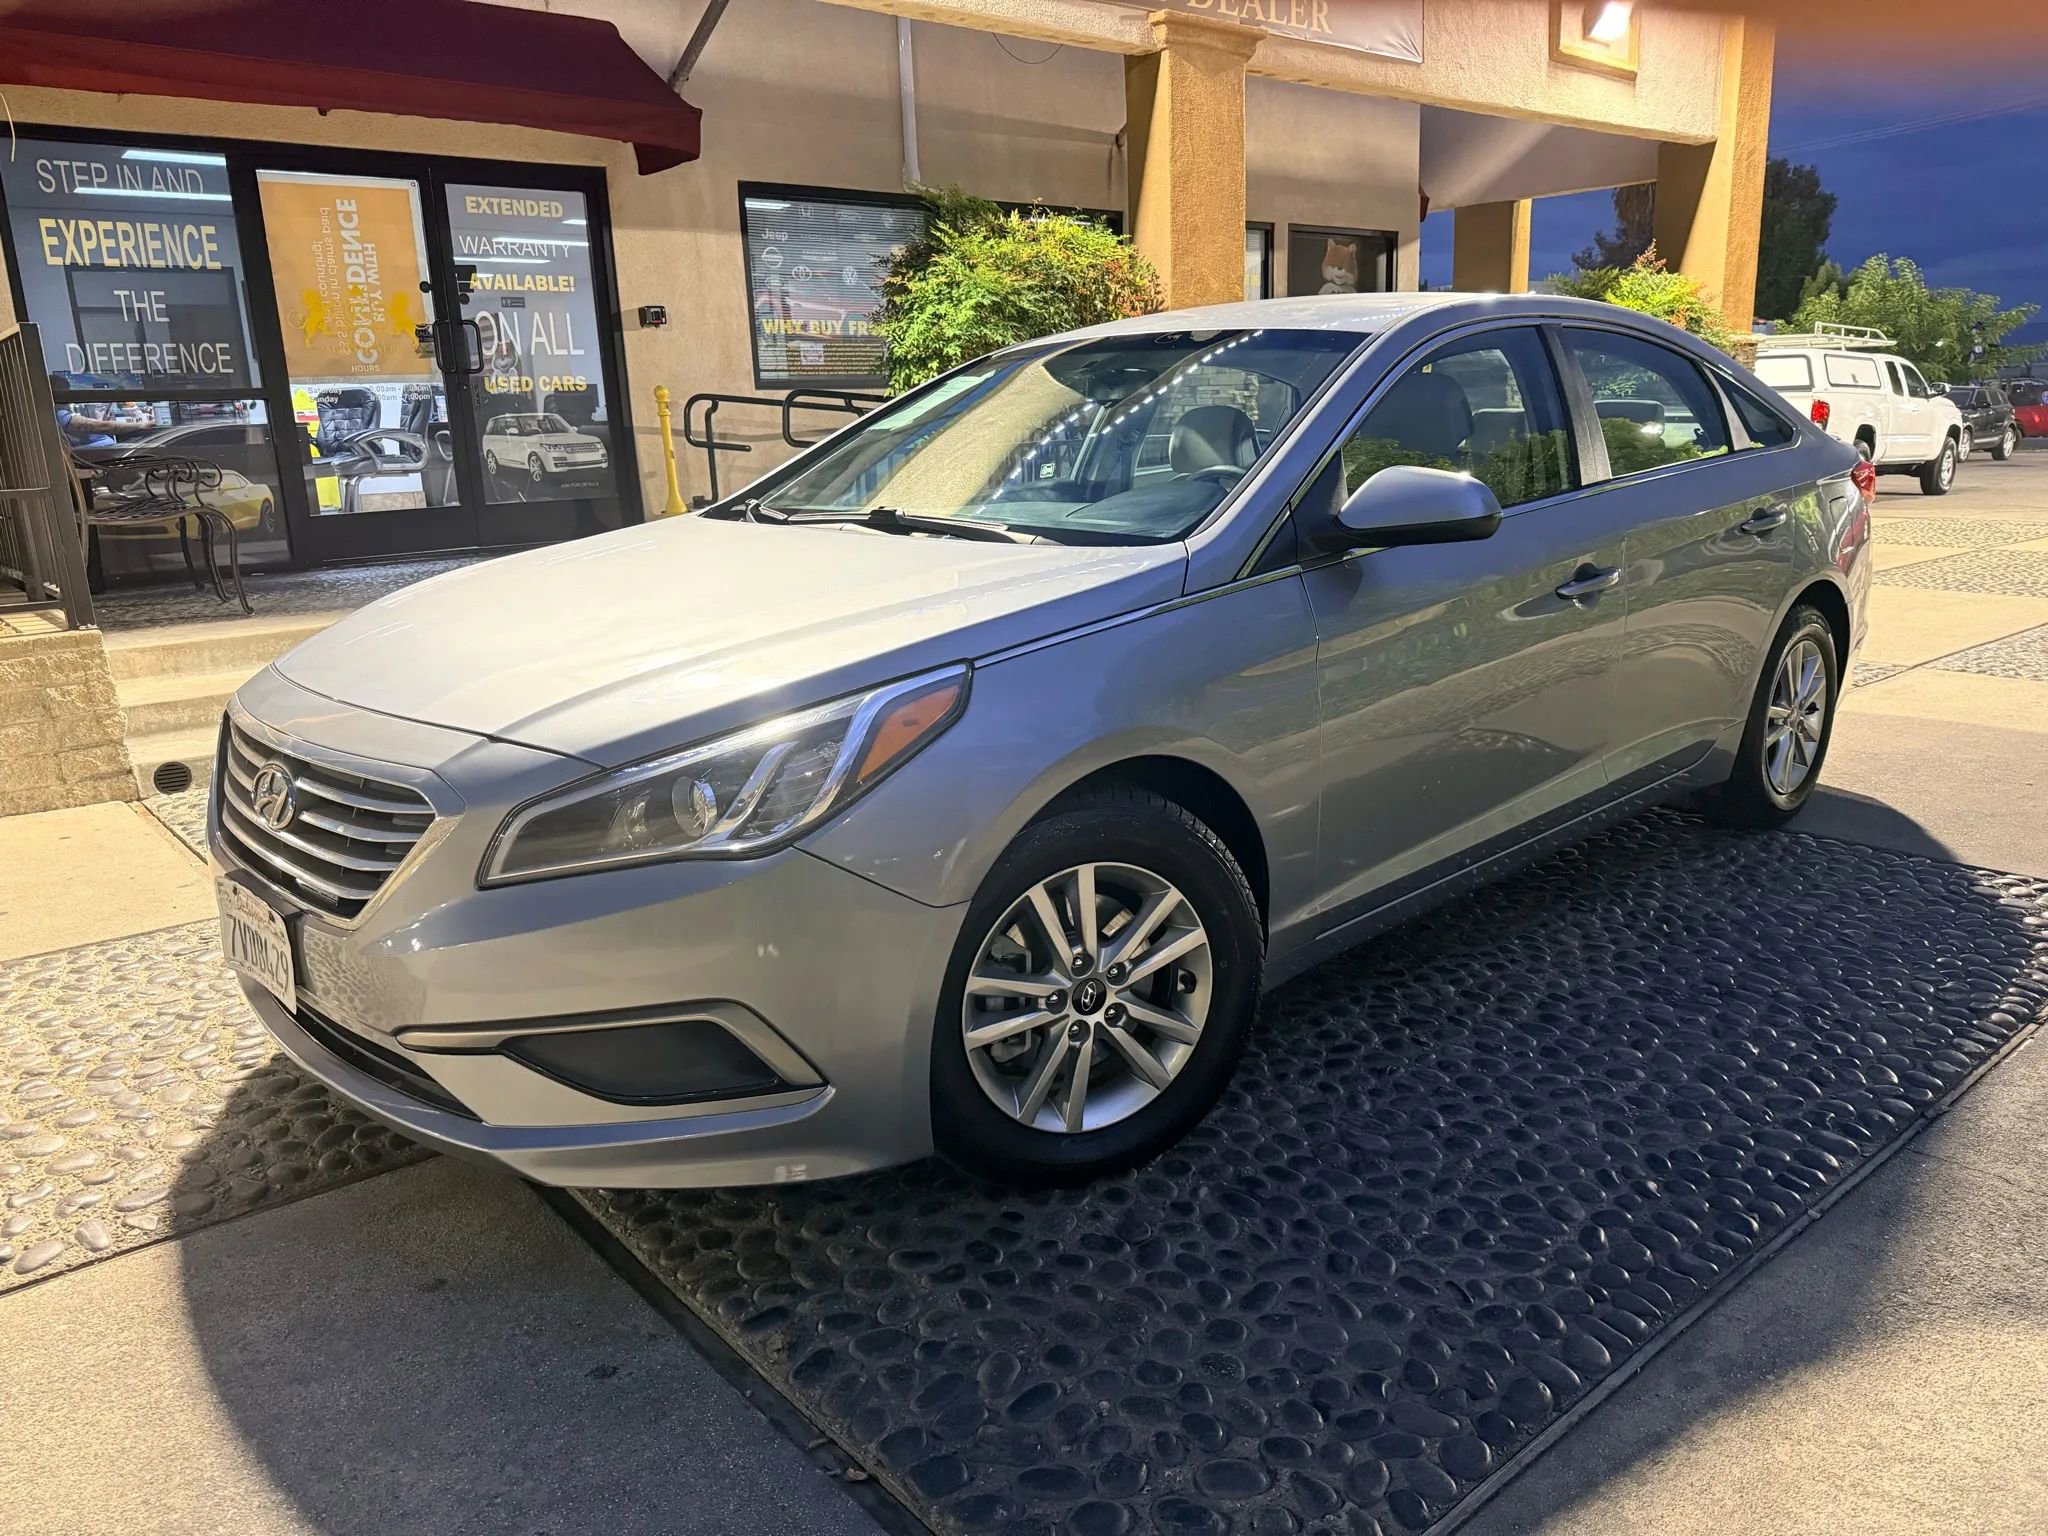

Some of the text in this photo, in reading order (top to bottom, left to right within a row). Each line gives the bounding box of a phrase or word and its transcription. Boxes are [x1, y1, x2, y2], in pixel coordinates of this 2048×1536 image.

[1186, 0, 1333, 34] ALER
[36, 158, 204, 197] STEP IN AND
[464, 196, 564, 218] EXTENDED
[39, 218, 222, 270] EXPERIENCE
[459, 235, 571, 258] WARRANTY
[761, 229, 788, 241] Jeep
[470, 273, 575, 292] AVAILABLE!
[113, 290, 170, 322] THE
[475, 310, 585, 356] ON ALL
[761, 319, 886, 336] WHY BUY FRO
[65, 343, 234, 375] DIFFERENCE
[351, 365, 381, 373] HOURS
[484, 376, 533, 394] USED
[539, 376, 587, 393] CARS
